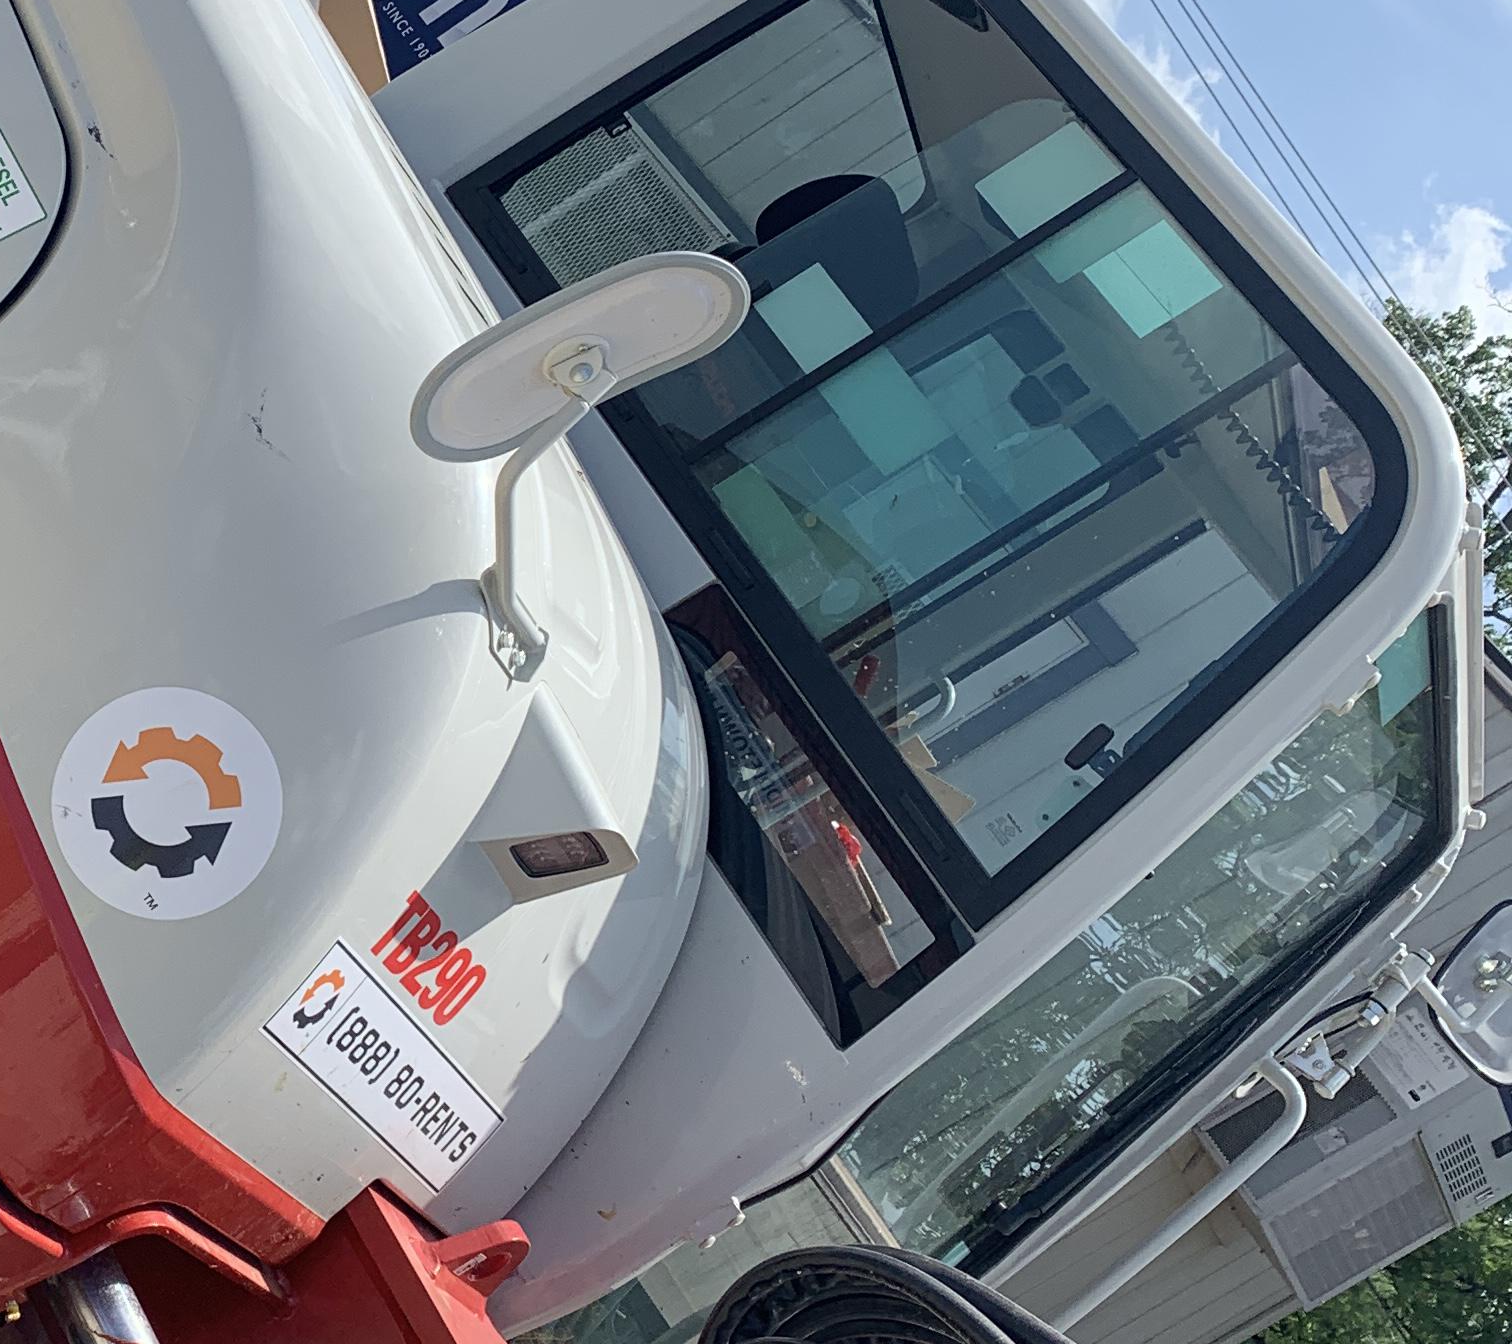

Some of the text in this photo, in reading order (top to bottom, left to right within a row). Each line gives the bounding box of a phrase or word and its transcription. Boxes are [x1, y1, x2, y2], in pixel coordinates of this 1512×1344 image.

[382, 1, 414, 37] SINCE
[409, 37, 433, 58] 190
[370, 890, 487, 1026] TB290
[326, 1006, 477, 1163] (888) 80-RENTS
